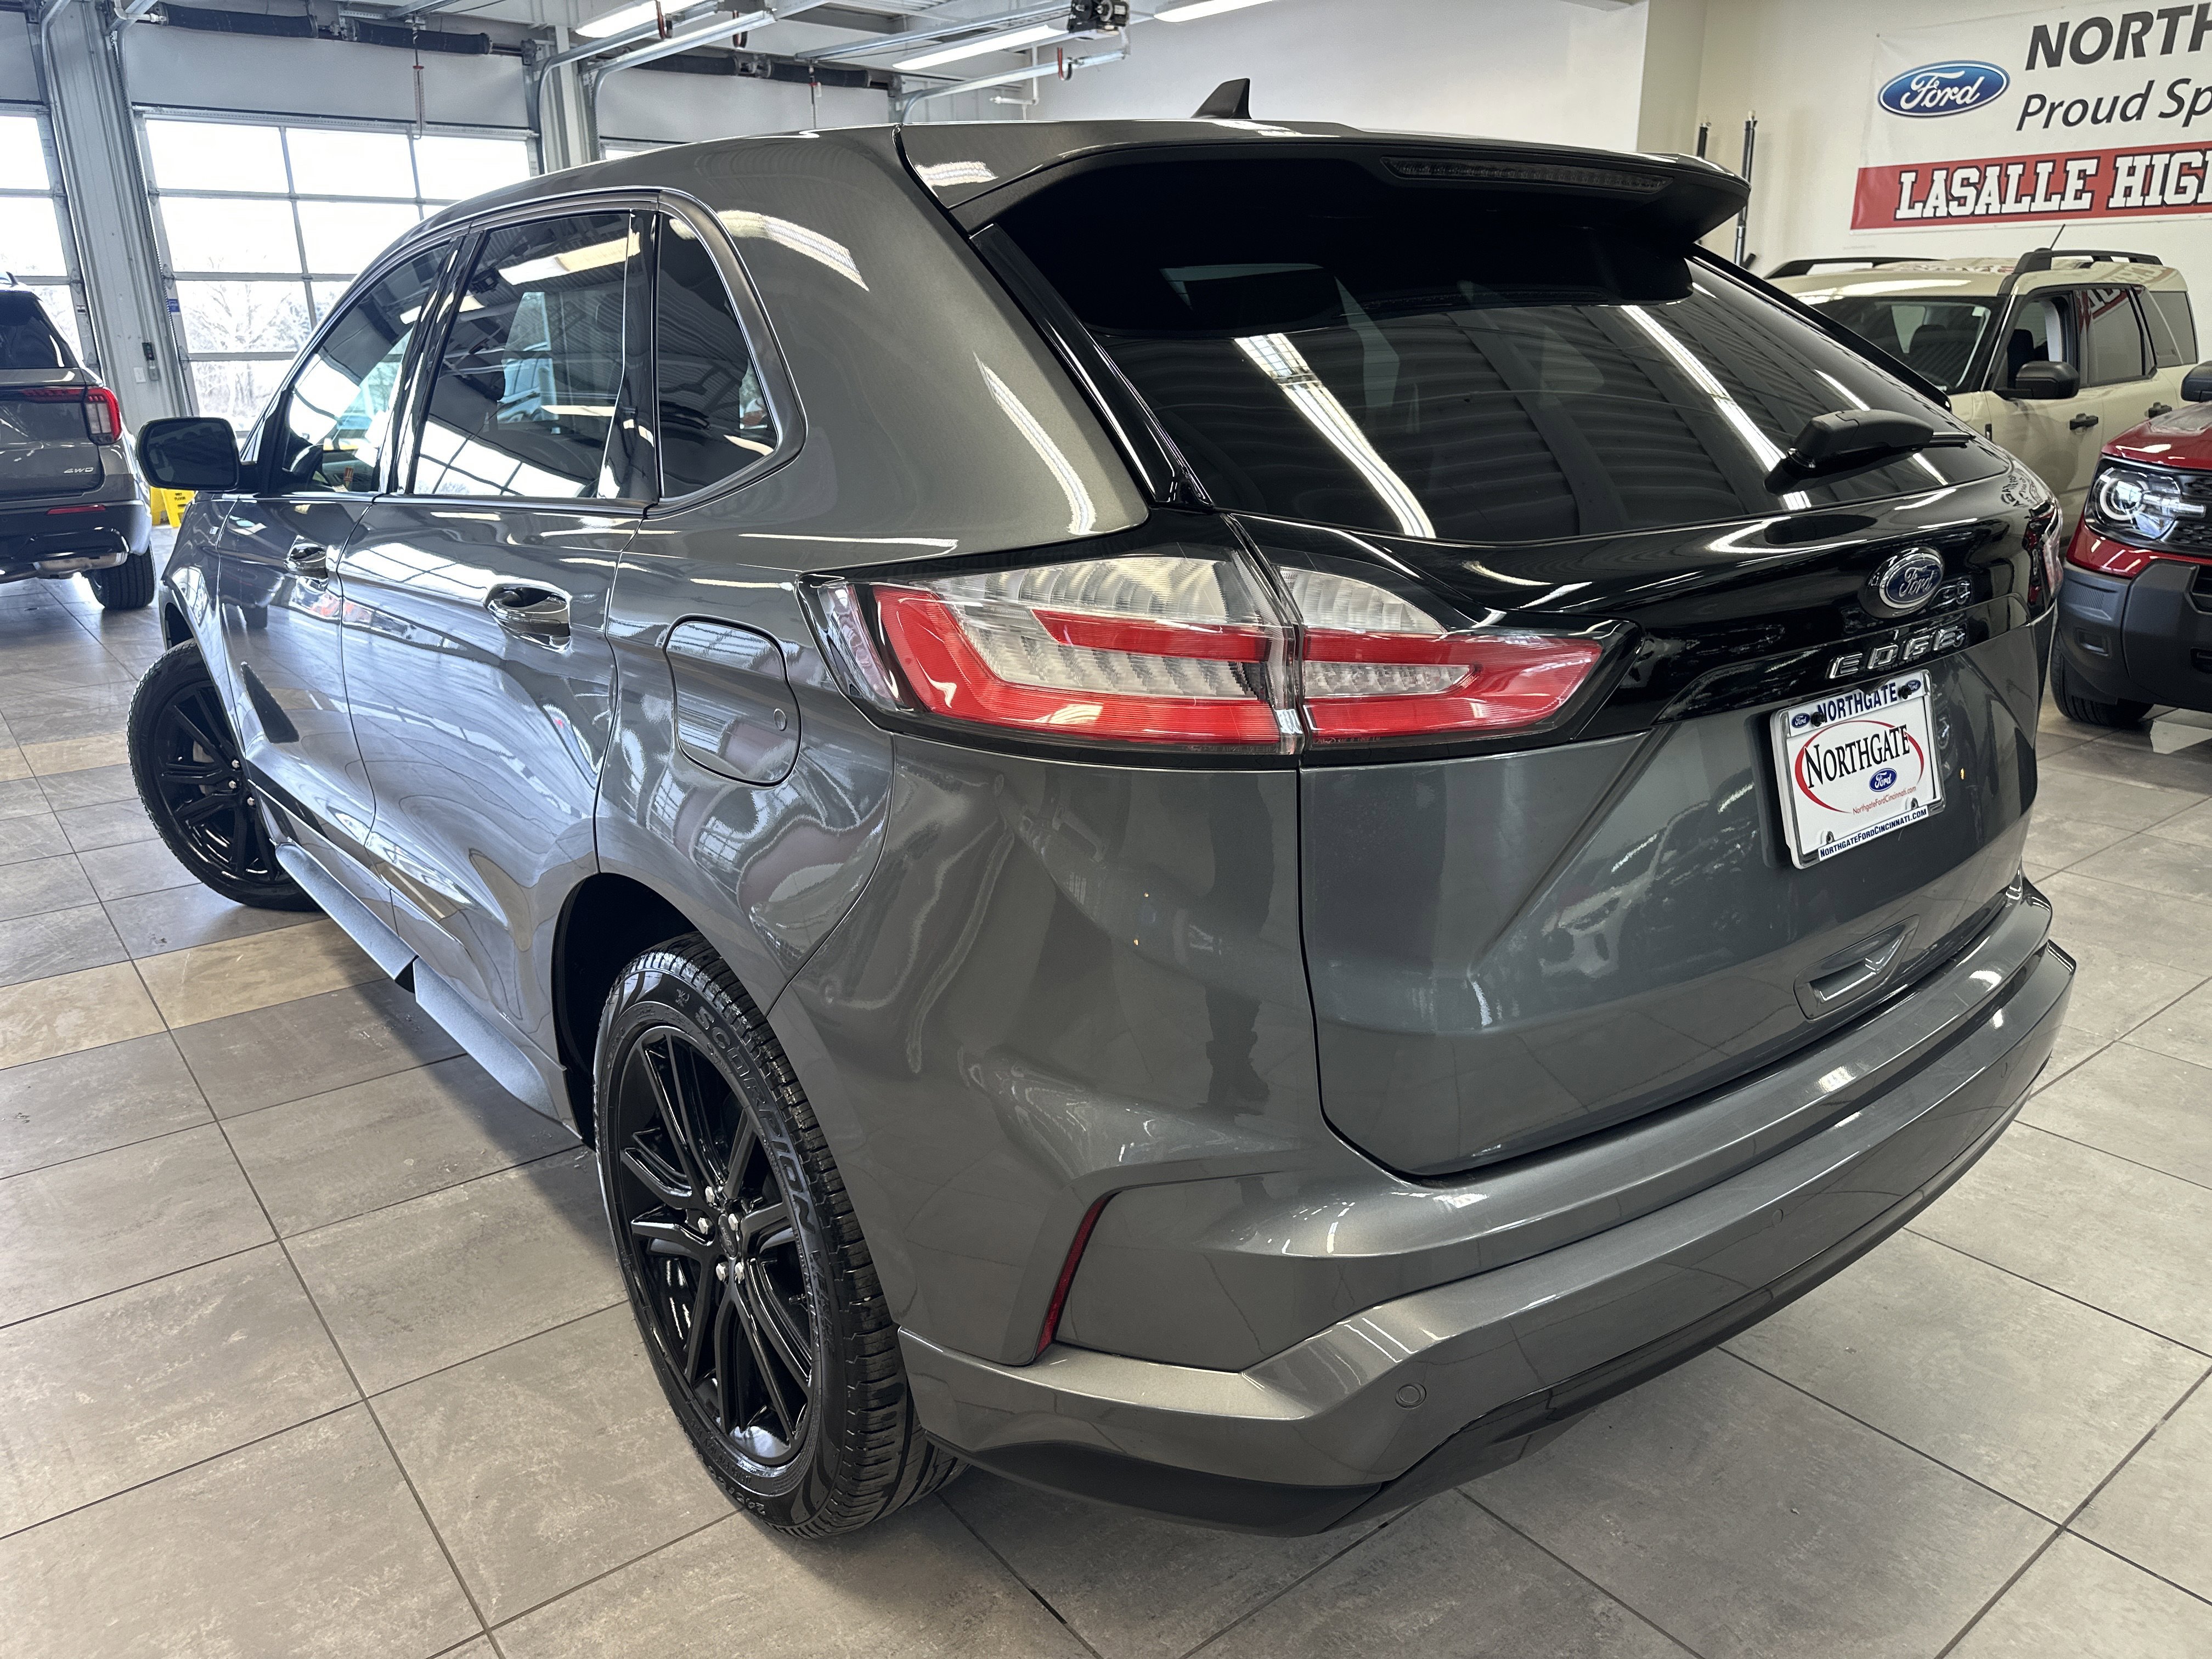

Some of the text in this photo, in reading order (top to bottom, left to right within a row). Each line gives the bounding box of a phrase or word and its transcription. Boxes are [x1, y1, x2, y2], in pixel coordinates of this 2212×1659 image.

[1899, 70, 1985, 110] Ford
[2016, 78, 2212, 132] Proud Sp
[1894, 156, 2100, 221] LASALLE
[1899, 563, 1938, 597] Ford
[1827, 625, 1960, 679] EDGE
[1803, 724, 1910, 788] NORTHGATE
[1852, 786, 1917, 815] NorthgateFordCincinnati.com
[694, 1005, 816, 1234] SCORPION
